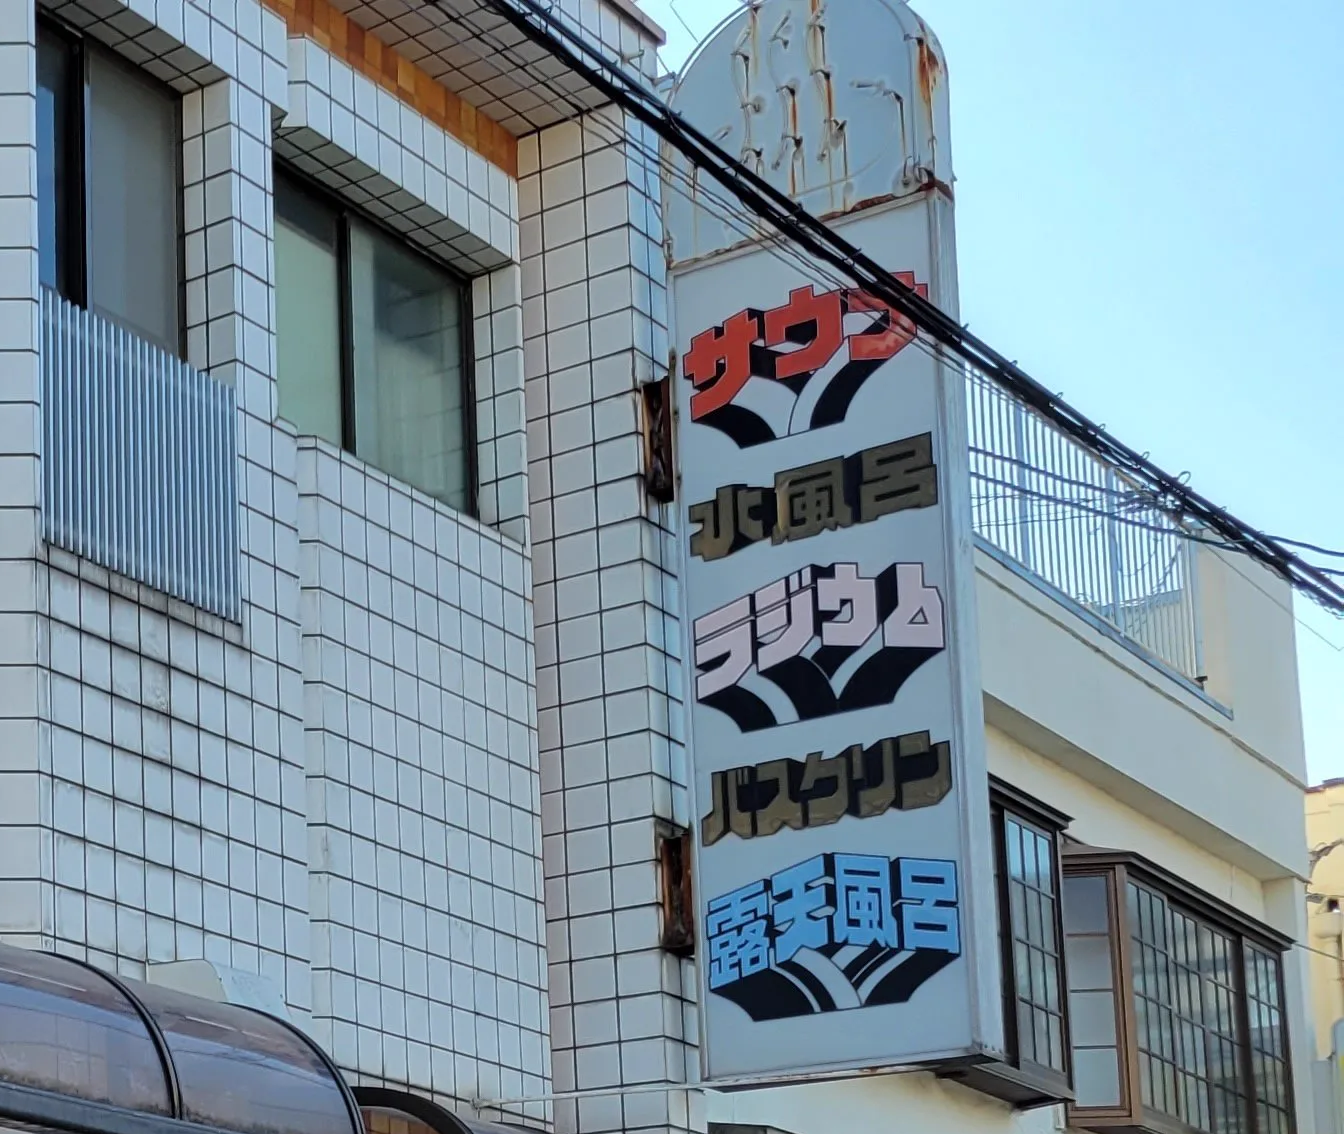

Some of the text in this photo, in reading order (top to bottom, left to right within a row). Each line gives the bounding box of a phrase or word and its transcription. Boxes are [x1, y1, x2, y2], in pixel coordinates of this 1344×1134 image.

[683, 271, 928, 421] サウナ
[688, 432, 939, 560] 水風呂
[694, 562, 945, 702] ラジウム
[702, 731, 952, 846] バスクリン
[707, 853, 961, 990] 露天風呂
